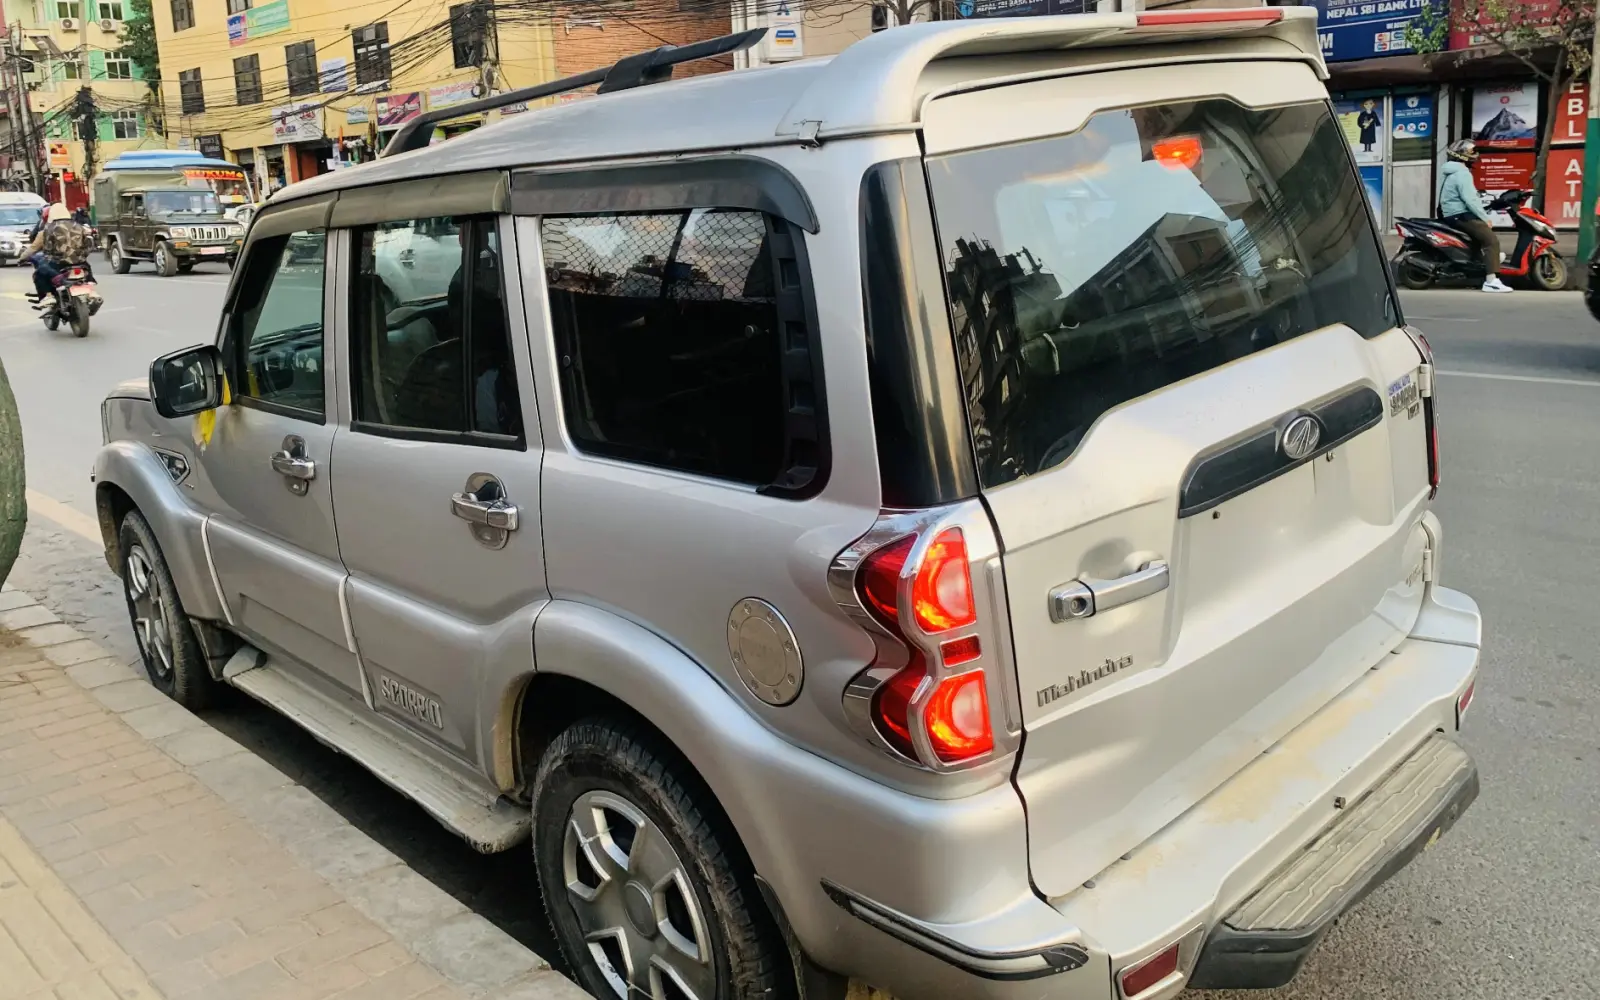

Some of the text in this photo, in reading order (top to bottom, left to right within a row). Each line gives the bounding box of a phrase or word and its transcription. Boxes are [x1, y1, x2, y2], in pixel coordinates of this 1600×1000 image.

[1326, 8, 1359, 20] NEPAL
[1360, 5, 1376, 15] SBI
[1377, 1, 1408, 13] BANK
[1564, 158, 1583, 219] ATM
[380, 675, 443, 730] SCORPIO
